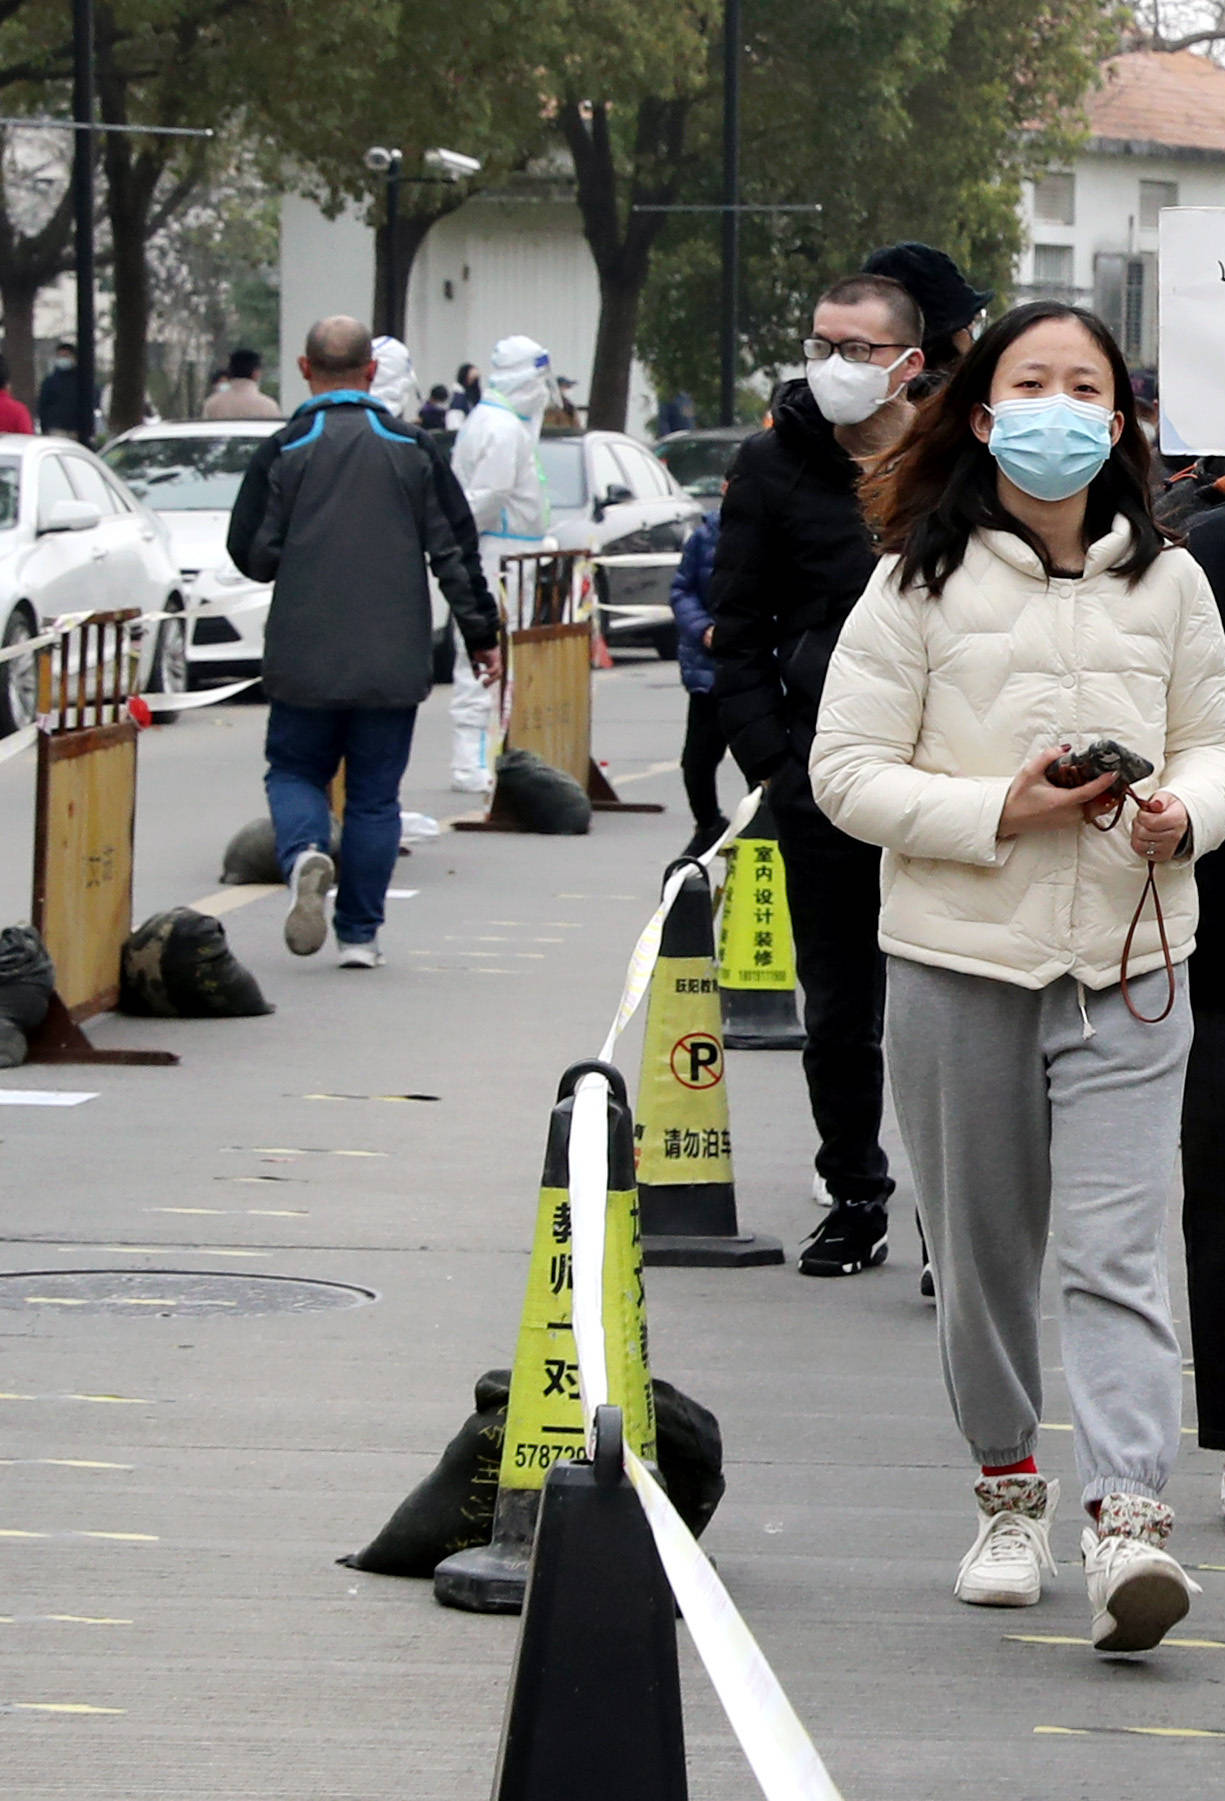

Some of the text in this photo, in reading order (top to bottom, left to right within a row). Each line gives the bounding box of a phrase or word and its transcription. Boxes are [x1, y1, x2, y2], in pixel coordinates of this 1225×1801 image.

[754, 846, 774, 967] 室内设计装修
